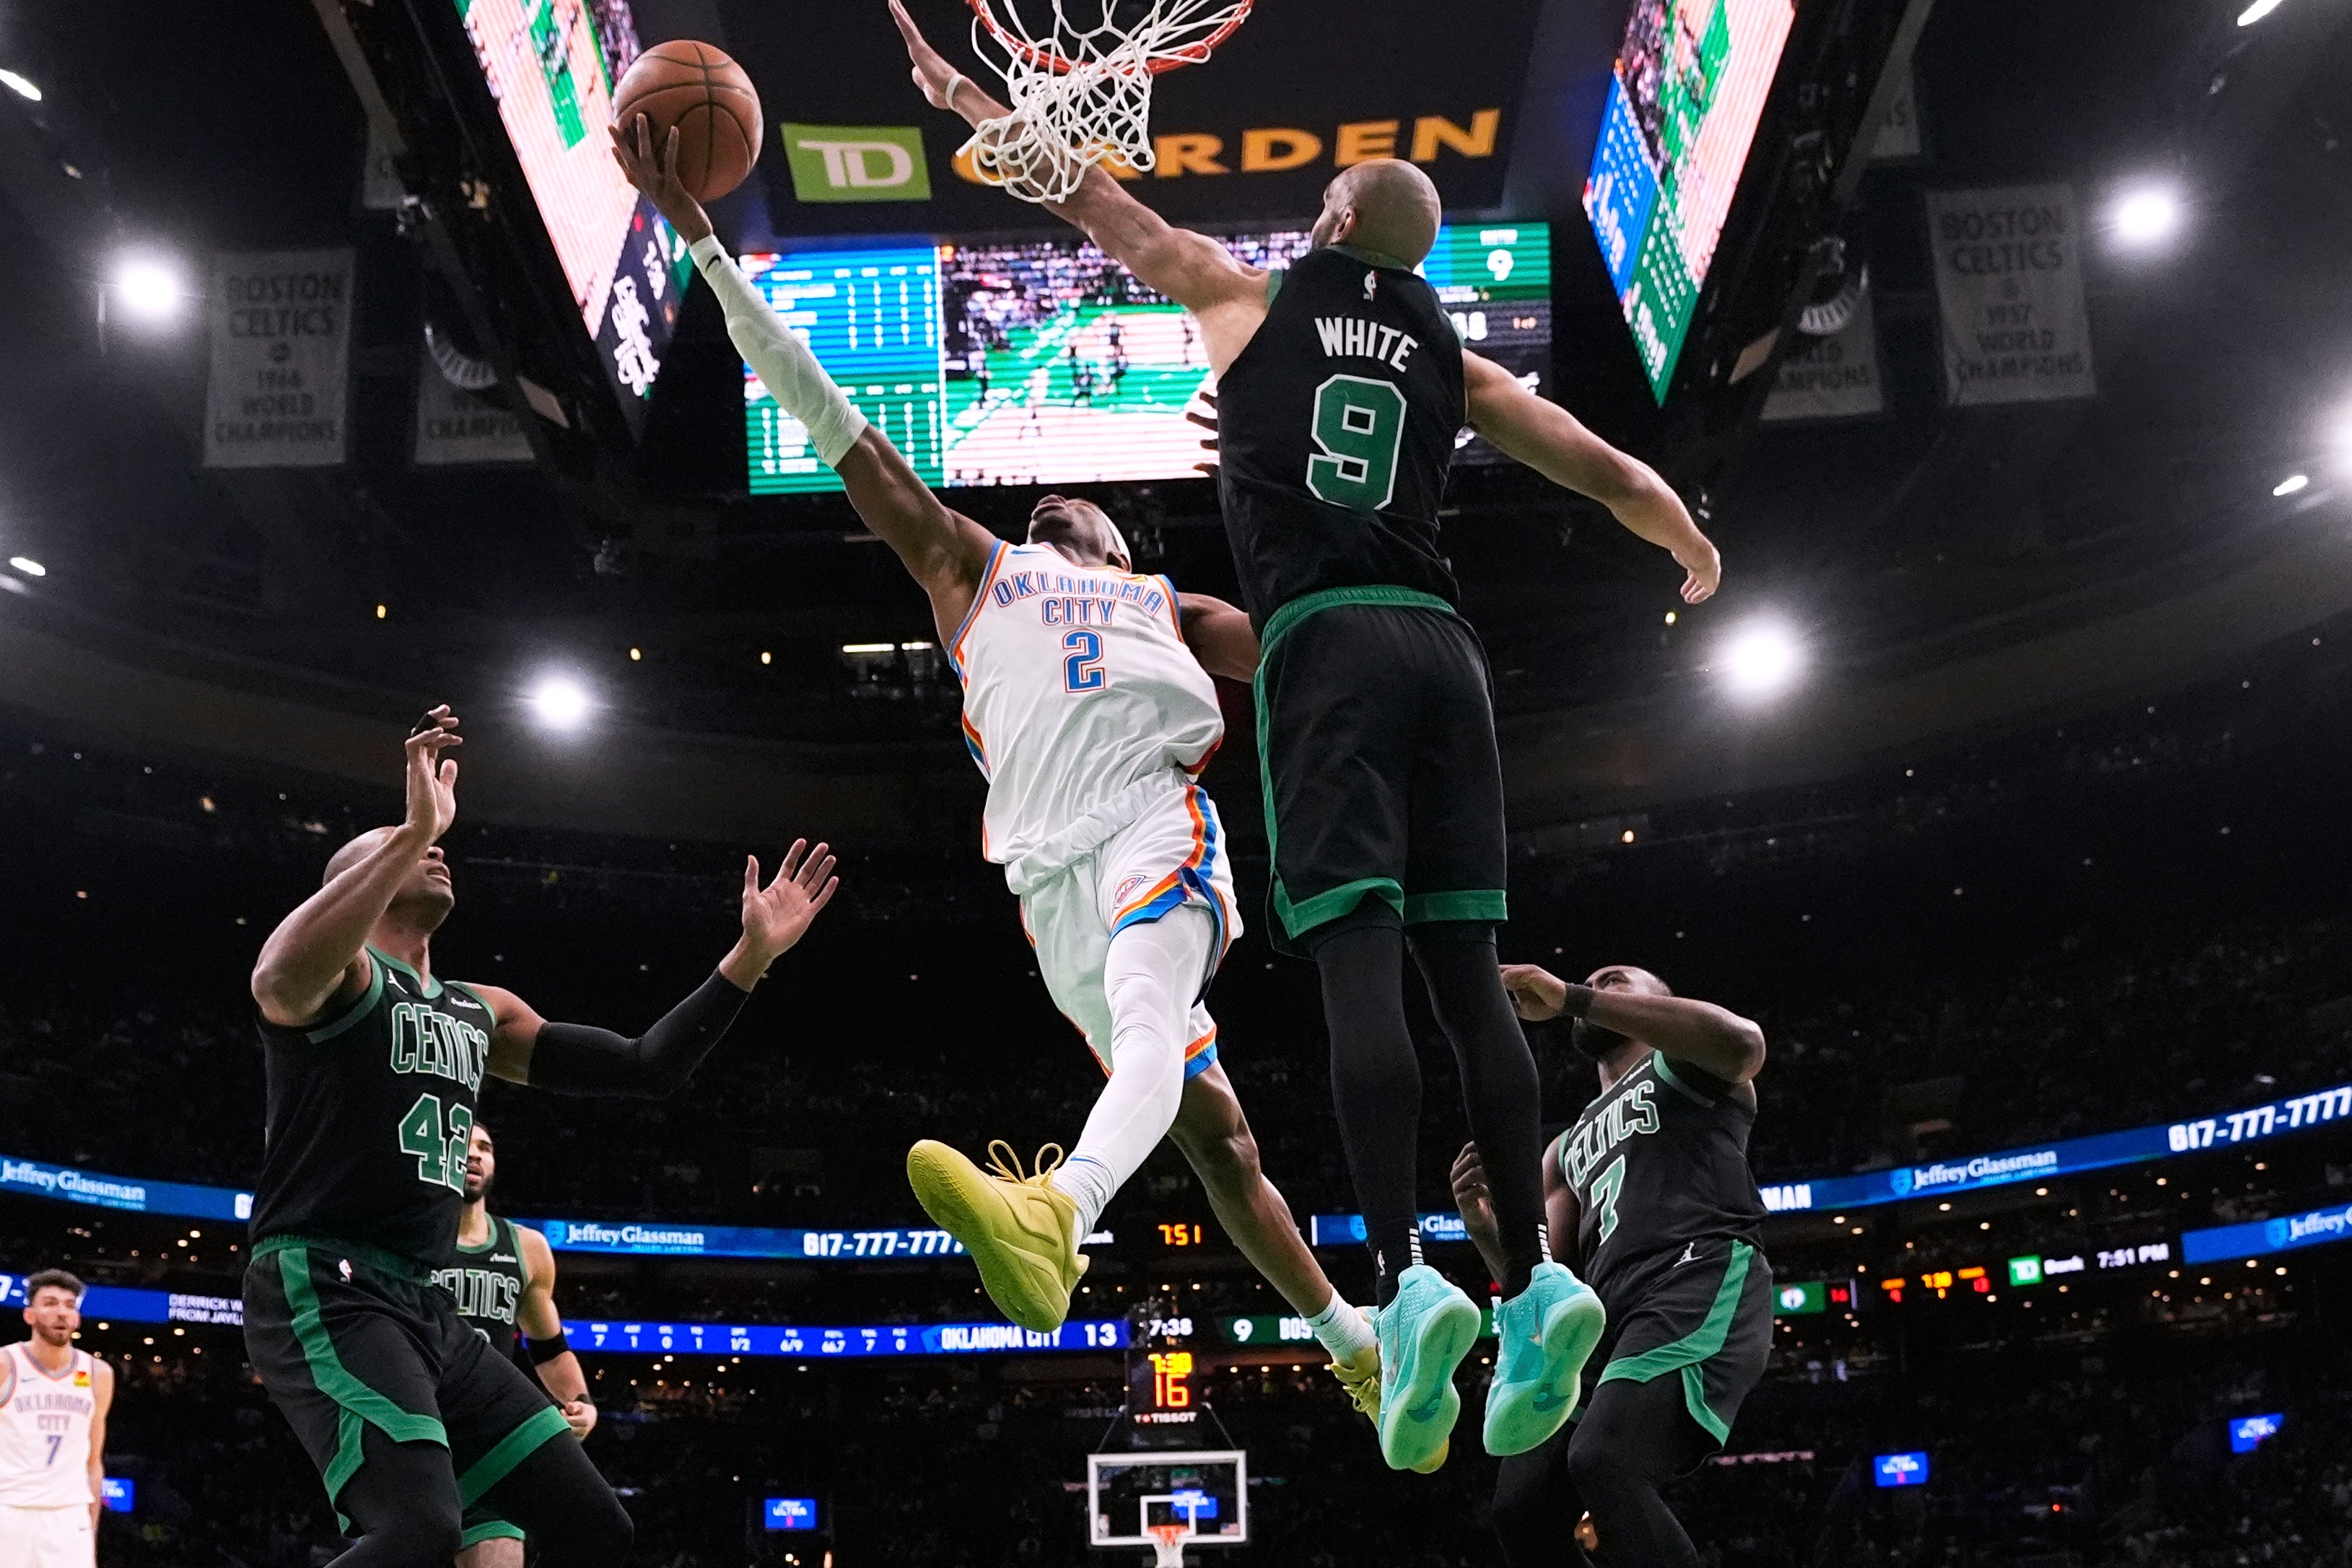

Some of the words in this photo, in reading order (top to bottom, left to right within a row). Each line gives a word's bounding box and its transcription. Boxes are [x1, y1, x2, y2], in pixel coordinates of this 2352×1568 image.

[797, 141, 913, 188] TD
[1940, 207, 2063, 240] BOSTON
[1486, 249, 1514, 281] 9
[1953, 241, 2063, 275] CELTICS
[227, 272, 343, 302] BOSTON
[228, 309, 336, 338] CELTICS
[1315, 317, 1418, 373] WHITE
[1306, 373, 1407, 509] 9
[992, 571, 1164, 617] OKLAHOMA
[1041, 596, 1116, 625] CITY
[1062, 628, 1106, 693] 2
[2168, 1086, 2352, 1152] 617-777-7777
[398, 1092, 473, 1198] 42
[1591, 1154, 1626, 1248] 7
[566, 1224, 621, 1247] Jeffrey
[621, 1226, 704, 1246] Glassman
[2097, 1247, 2135, 1269] 7:51
[2138, 1242, 2169, 1263] PM
[168, 1307, 211, 1323] FROM
[1149, 1318, 1193, 1336] 7:38
[1233, 1318, 1253, 1341] 9
[941, 1326, 1024, 1349] OKLAHOMA
[1084, 1323, 1118, 1347] 13
[14, 1393, 92, 1416] OKLAHOMA
[1155, 1373, 1189, 1407] 16
[38, 1414, 71, 1432] CITY
[1150, 1412, 1197, 1423] TISSOT
[47, 1435, 63, 1466] 7
